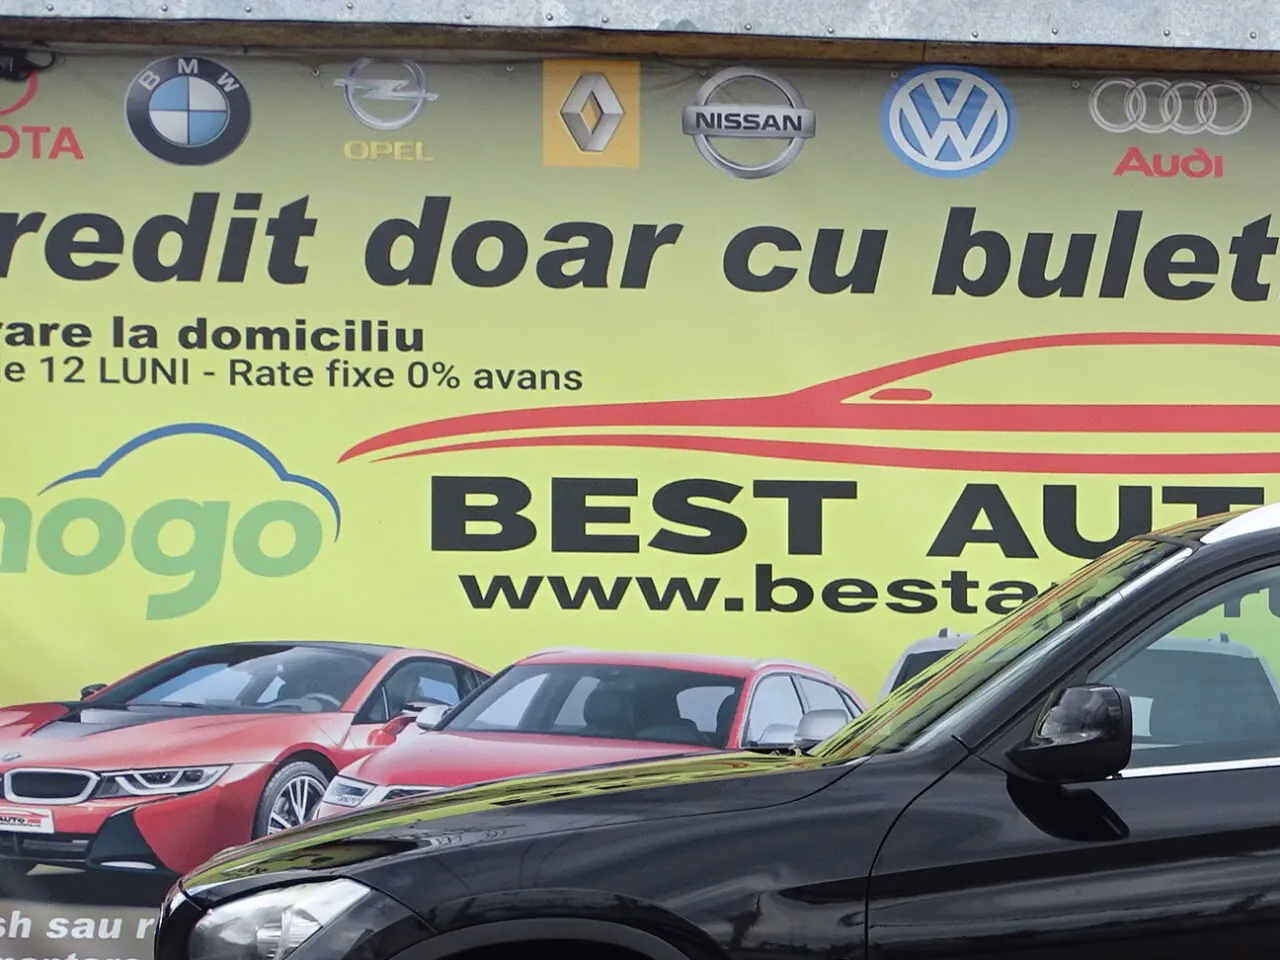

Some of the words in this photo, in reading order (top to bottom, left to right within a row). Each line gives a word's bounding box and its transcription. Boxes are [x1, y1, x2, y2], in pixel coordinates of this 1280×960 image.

[137, 57, 241, 95] BMW
[695, 110, 803, 133] NISSAN
[343, 139, 435, 162] OPEL
[0, 192, 318, 284] redit
[364, 195, 684, 289] doar
[723, 224, 889, 296] cu
[0, 321, 93, 348] are
[113, 315, 158, 349] la
[178, 317, 425, 352] domiciliu
[40, 355, 86, 383] 12
[100, 356, 189, 385] LUNI
[229, 359, 314, 388] Rate
[326, 357, 396, 389] fixe
[408, 360, 461, 390] 0%
[473, 367, 584, 391] avans
[431, 475, 857, 556] BEST
[46, 917, 123, 939] sau
